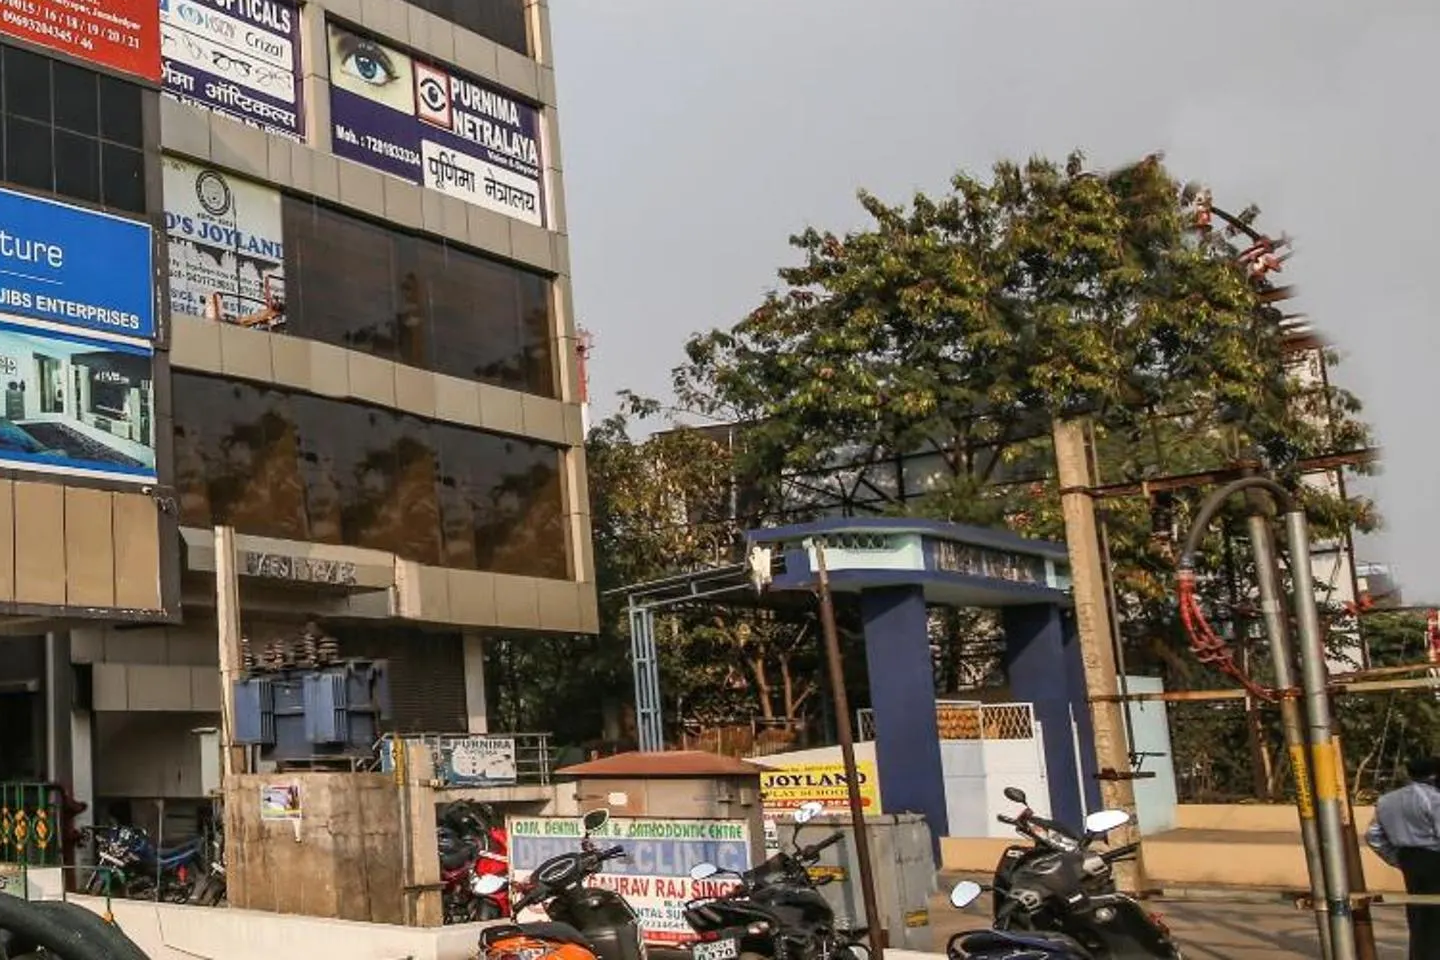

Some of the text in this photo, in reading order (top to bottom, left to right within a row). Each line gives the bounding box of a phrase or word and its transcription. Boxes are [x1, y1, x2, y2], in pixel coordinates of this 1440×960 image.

[245, 32, 283, 58] Crizal
[452, 76, 520, 127] PURNIMA
[452, 110, 538, 166] NETRALAYA
[428, 151, 536, 213] पूर्णिमा नेत्रालय
[36, 295, 140, 330] ENTERPRISES
[655, 879, 686, 899] RAJ
